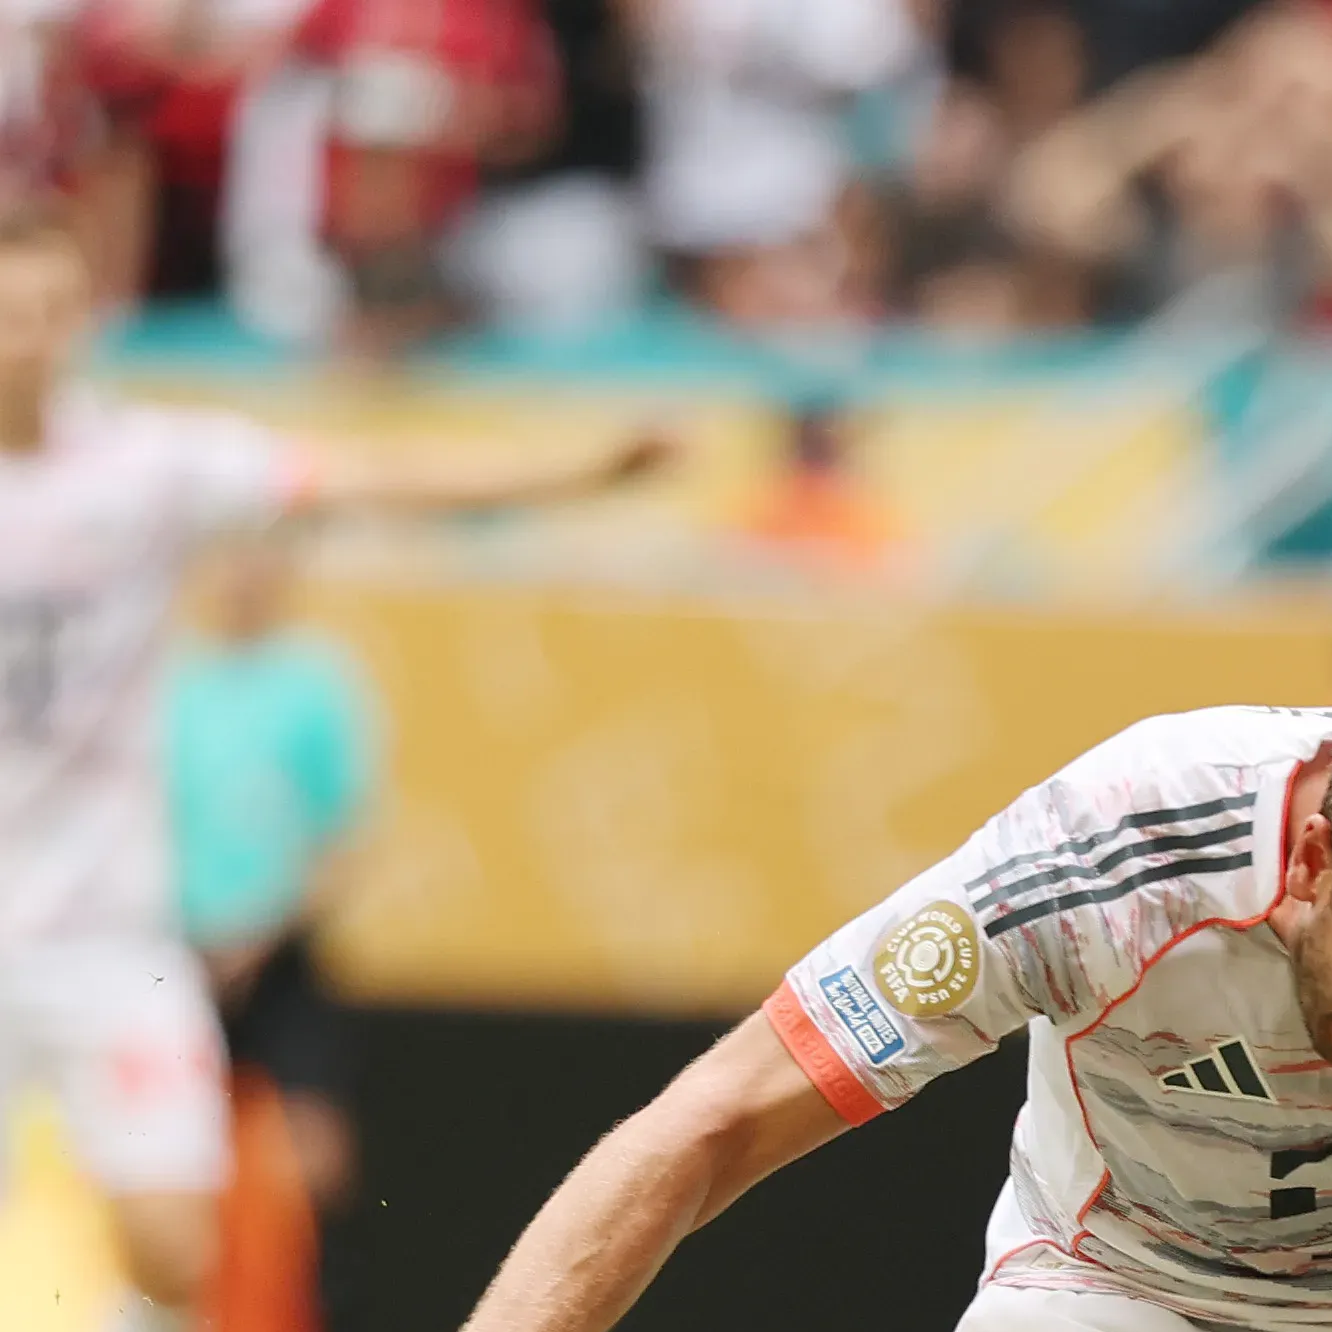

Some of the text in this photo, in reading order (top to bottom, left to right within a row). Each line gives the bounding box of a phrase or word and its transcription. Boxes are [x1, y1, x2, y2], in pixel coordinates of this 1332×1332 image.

[918, 910, 962, 934] WORLD
[957, 937, 973, 969] CUP
[880, 962, 910, 1003] FIFA
[917, 989, 950, 1004] USA
